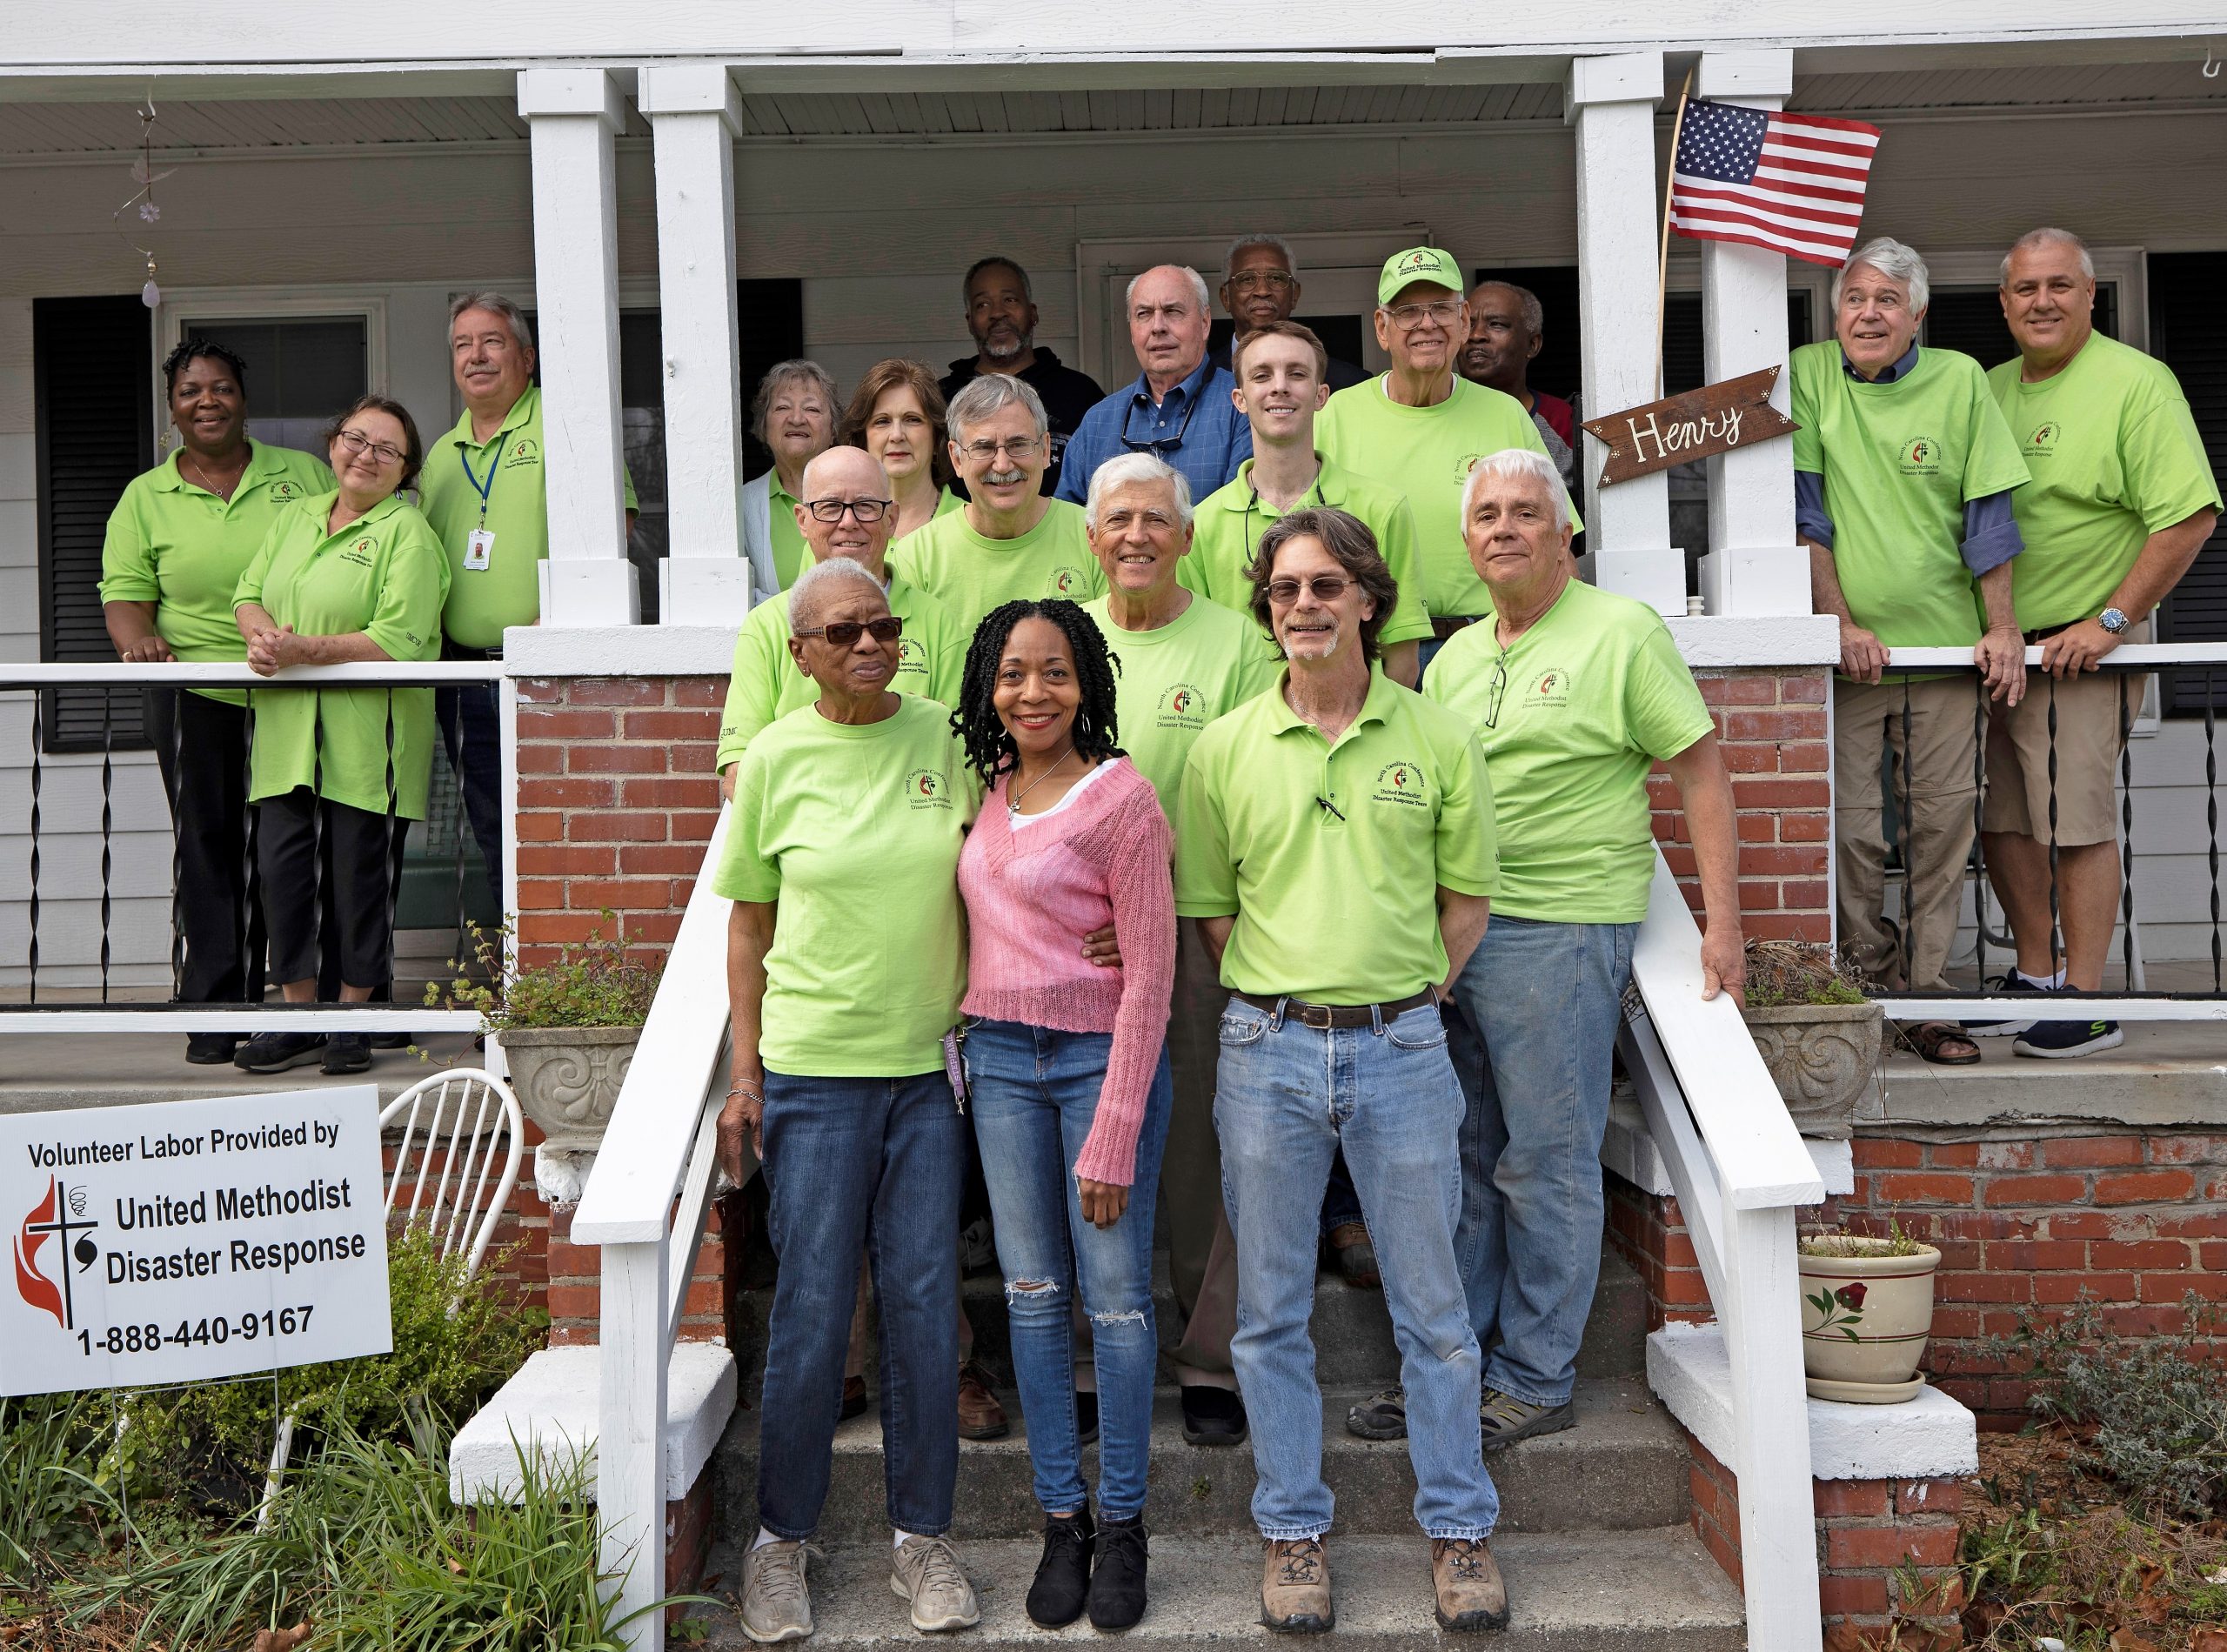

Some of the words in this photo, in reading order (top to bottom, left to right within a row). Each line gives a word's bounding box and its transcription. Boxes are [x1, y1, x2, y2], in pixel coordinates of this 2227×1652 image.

[1626, 406, 1743, 463] Henry
[1461, 452, 1481, 461] Carolina
[1905, 436, 1925, 446] Carolina
[1926, 436, 1942, 461] Conference
[1051, 566, 1069, 577] Carolina
[1535, 667, 1557, 679] Carolina
[1166, 683, 1189, 693] Carolina
[1190, 685, 1206, 713] Conference
[1177, 715, 1204, 724] Methodist
[1179, 722, 1204, 731] Response
[908, 768, 928, 779] Carolina
[1377, 769, 1387, 783] North
[1386, 761, 1407, 770] Carolina
[1408, 762, 1425, 787] Conference
[1394, 797, 1414, 806] Response
[1398, 791, 1421, 799] Methodist
[946, 1033, 960, 1081] STEPHANIE
[28, 1140, 134, 1168] Volunteer
[140, 1134, 204, 1160] Labor
[211, 1122, 307, 1154] Provided
[313, 1120, 339, 1148] by
[116, 1191, 206, 1231] United
[216, 1177, 351, 1221] Methodist
[106, 1247, 222, 1284] Disaster
[231, 1233, 366, 1274] Response
[77, 1305, 314, 1356] 1-888-440-9167
